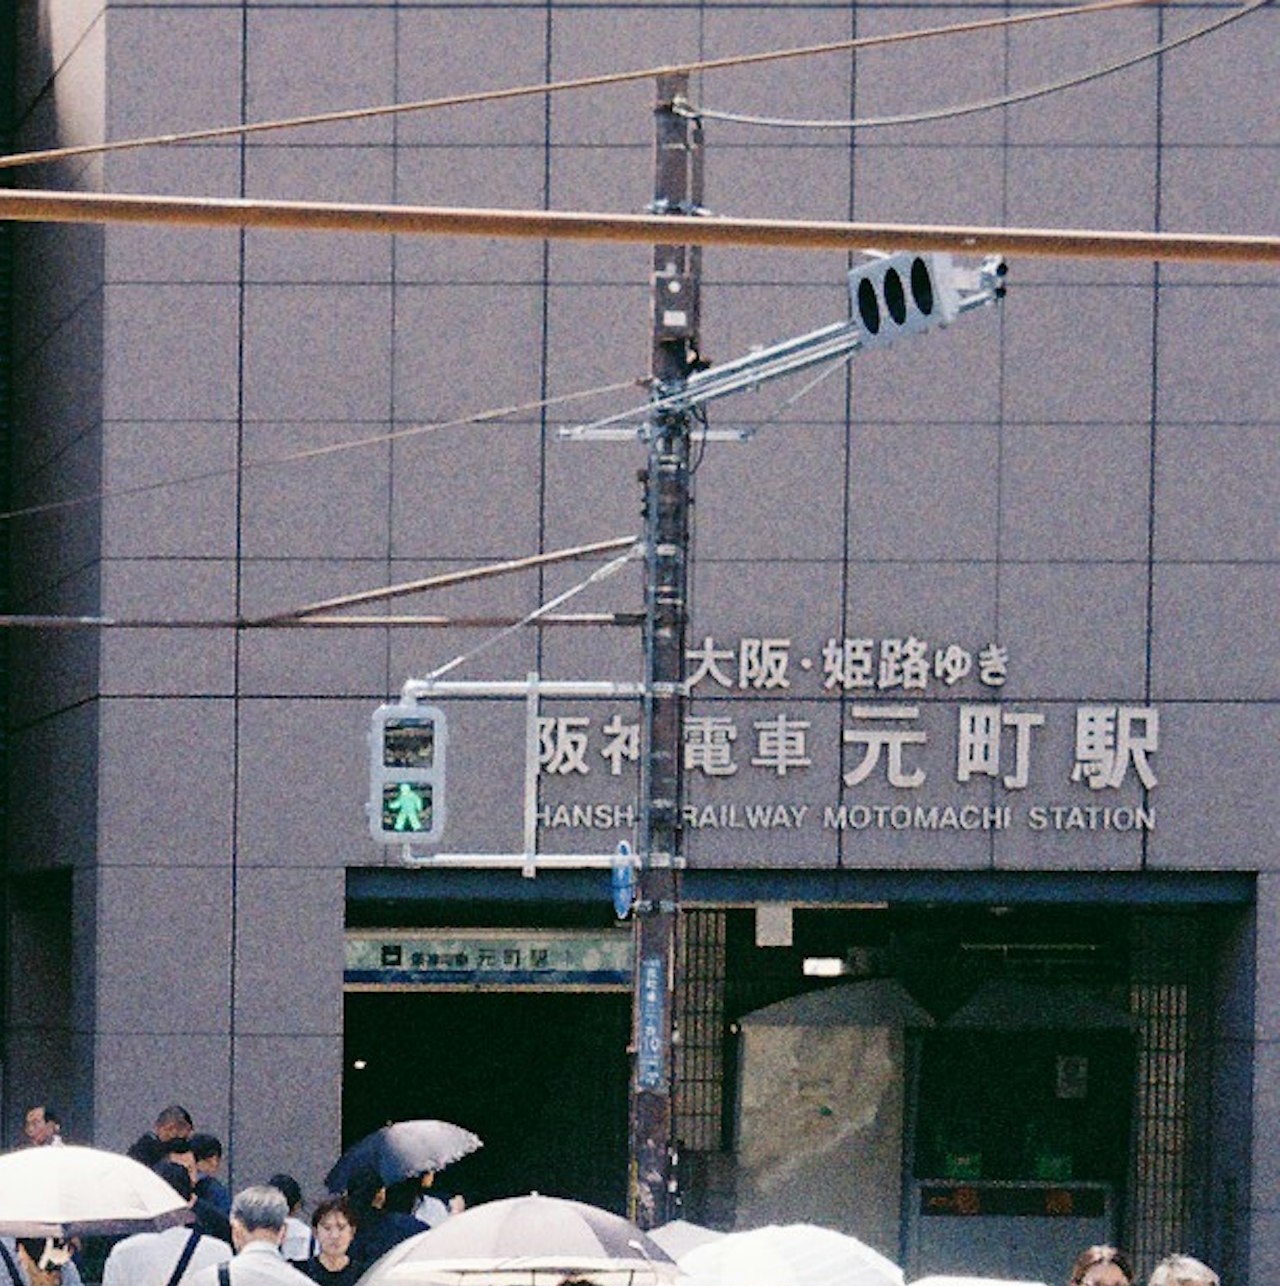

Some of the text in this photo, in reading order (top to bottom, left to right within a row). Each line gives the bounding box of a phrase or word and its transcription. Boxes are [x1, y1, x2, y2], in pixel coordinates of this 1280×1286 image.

[685, 637, 1008, 690] 大阪・姫路ゆき
[842, 704, 1159, 790] 元町駅
[682, 804, 808, 829] RAILWAY
[823, 804, 1011, 830] MOTOMACHI
[1028, 805, 1156, 830] STATION
